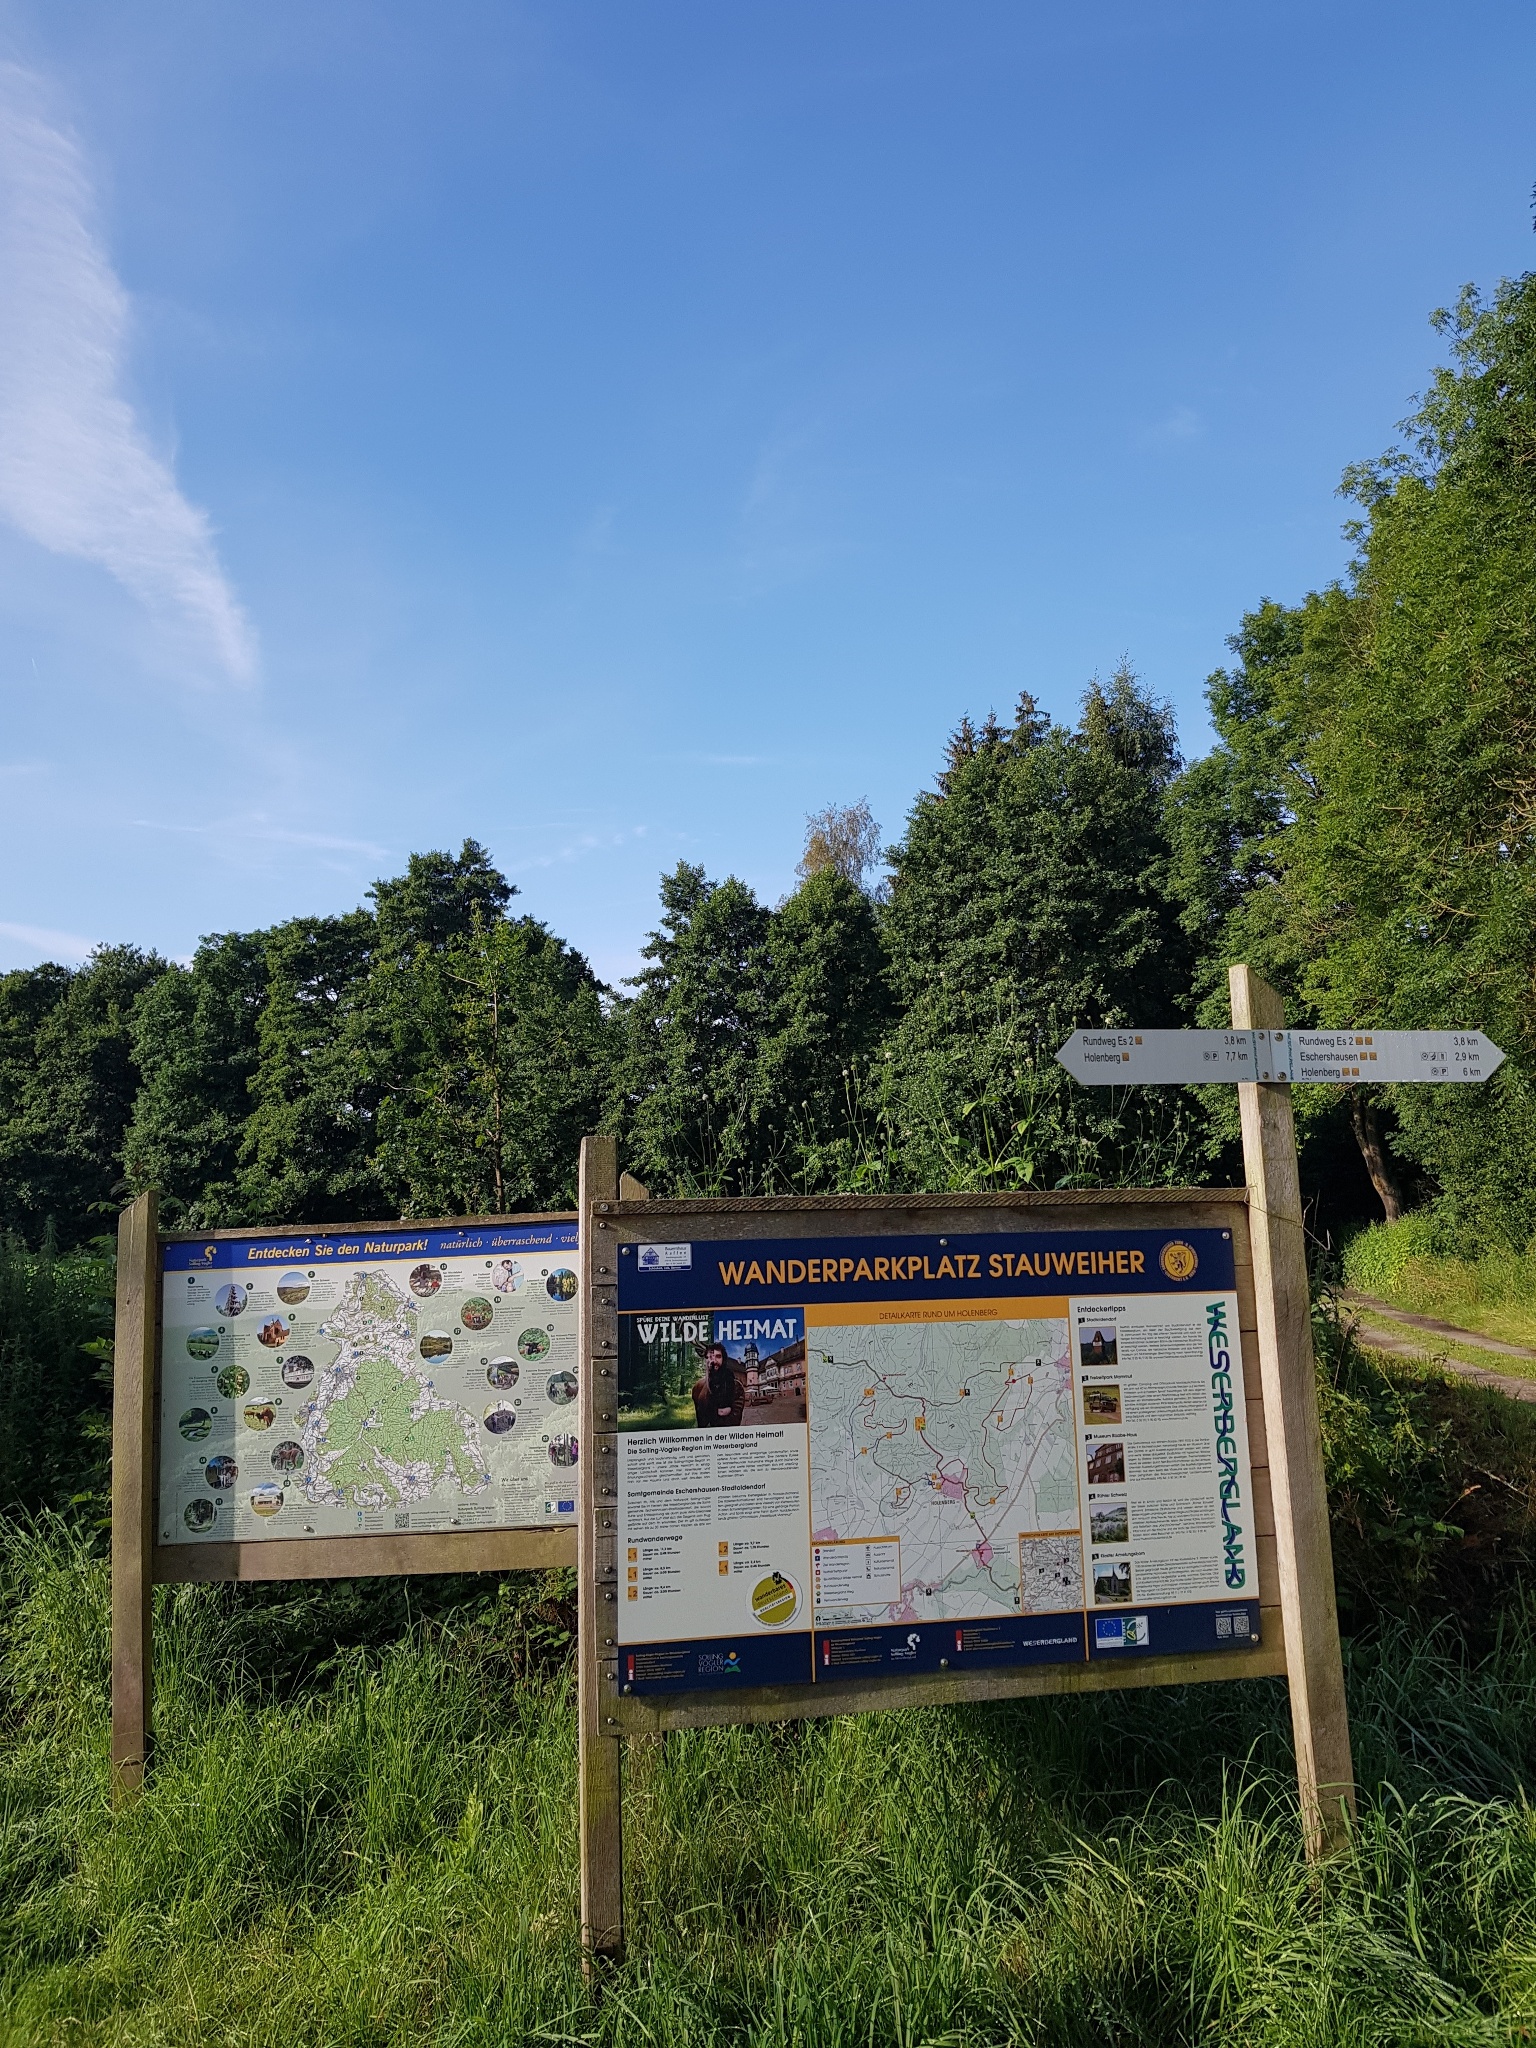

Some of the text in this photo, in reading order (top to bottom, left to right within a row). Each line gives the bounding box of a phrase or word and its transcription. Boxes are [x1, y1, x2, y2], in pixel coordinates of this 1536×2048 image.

[1082, 1036, 1134, 1047] Rundweg Es 2
[1224, 1035, 1247, 1045] 3,8 km
[1299, 1037, 1354, 1048] Rundweg Es 2
[1453, 1037, 1479, 1046] 3,8 km
[1084, 1053, 1121, 1064] Holenberg
[1225, 1051, 1248, 1062] 7,7 km
[1300, 1052, 1359, 1061] Eschershausen
[1455, 1052, 1480, 1062] 2,9 km
[1301, 1067, 1341, 1078] Holenberg
[1462, 1067, 1481, 1076] 6 km
[440, 1232, 579, 1250] natürlich überraschend viel
[247, 1239, 429, 1260] Entdecken Sie den Naturpark!
[718, 1254, 982, 1286] WANDERPARKPLATZ
[988, 1249, 1146, 1278] STAUWEIHER
[879, 1311, 921, 1320] DETAILKARTE
[922, 1310, 943, 1318] RUND
[957, 1308, 998, 1317] HOLENBERG
[1077, 1305, 1126, 1313] Entdeckertipps
[637, 1318, 798, 1344] WILDE HEIMAT
[627, 1438, 657, 1446] Herzlich
[659, 1435, 704, 1444] Willkommen
[714, 1433, 728, 1441] der
[729, 1432, 754, 1440] Wilden
[755, 1430, 784, 1439] Heimat!
[1205, 1300, 1246, 1590] WESERBERGLAND
[627, 1535, 683, 1544] Rundwanderwege
